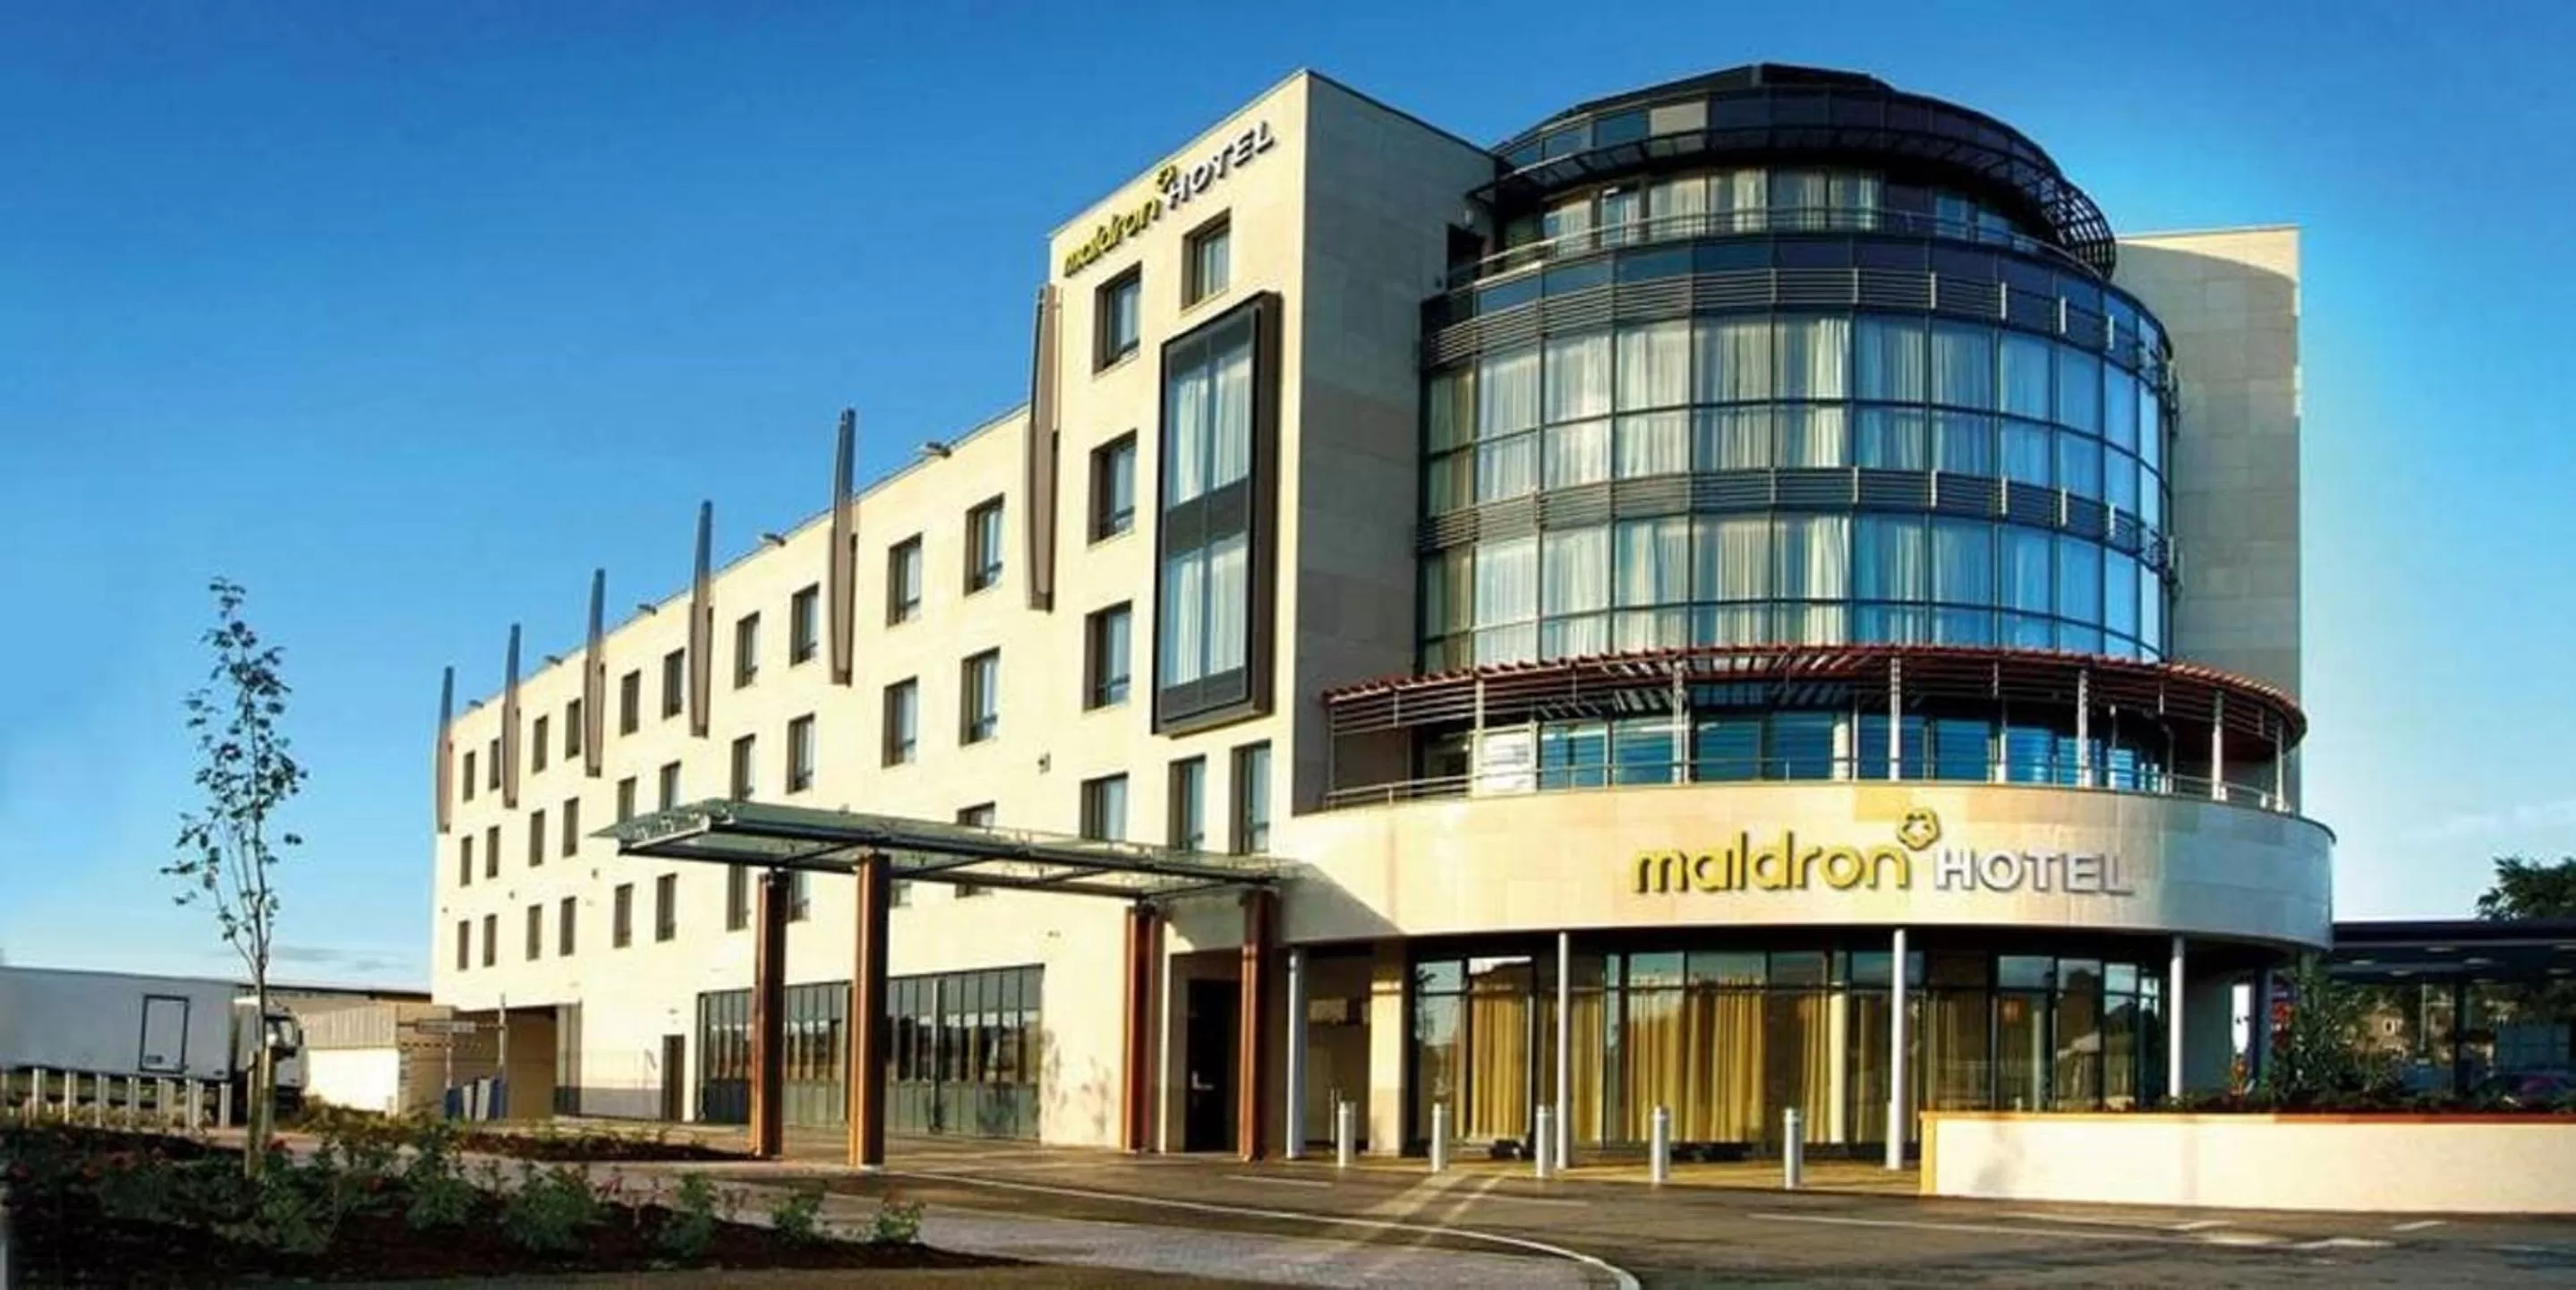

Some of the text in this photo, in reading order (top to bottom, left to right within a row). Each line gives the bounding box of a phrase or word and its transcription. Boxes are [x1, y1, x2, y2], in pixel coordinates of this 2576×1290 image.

[1062, 121, 1275, 278] maldron HOTEL
[1633, 831, 2135, 896] maldron HOTEL
